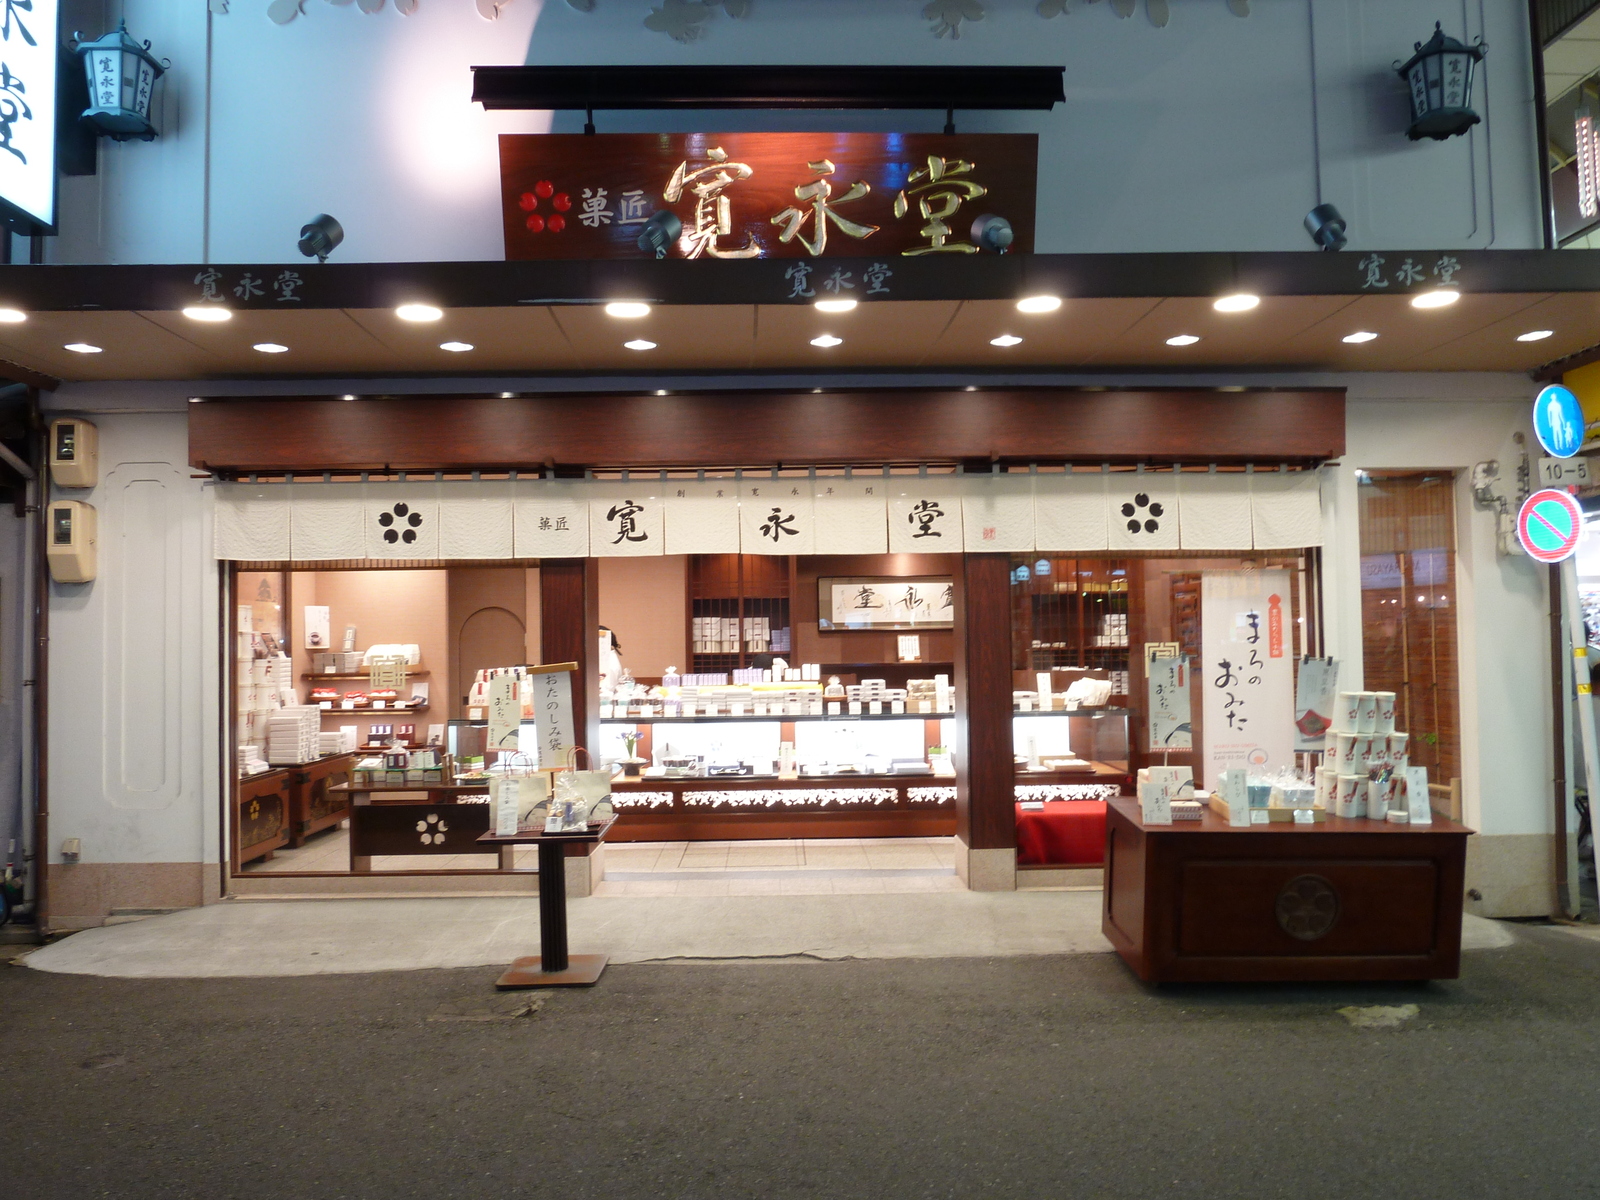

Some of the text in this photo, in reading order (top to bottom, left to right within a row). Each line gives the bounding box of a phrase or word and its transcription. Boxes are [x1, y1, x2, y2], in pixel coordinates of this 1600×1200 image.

[99, 57, 114, 106] 寛永堂
[1447, 59, 1461, 105] 寛永堂
[578, 146, 988, 259] 菓匠 寛永堂
[194, 268, 304, 304] 寛永堂
[784, 263, 894, 298] 寛永堂
[1358, 253, 1461, 289] 寛永堂
[538, 500, 944, 544] 菓匠 寛永堂
[1245, 608, 1264, 686] まろの
[546, 675, 562, 750] おたのしみ袋
[1214, 658, 1248, 732] おみた
